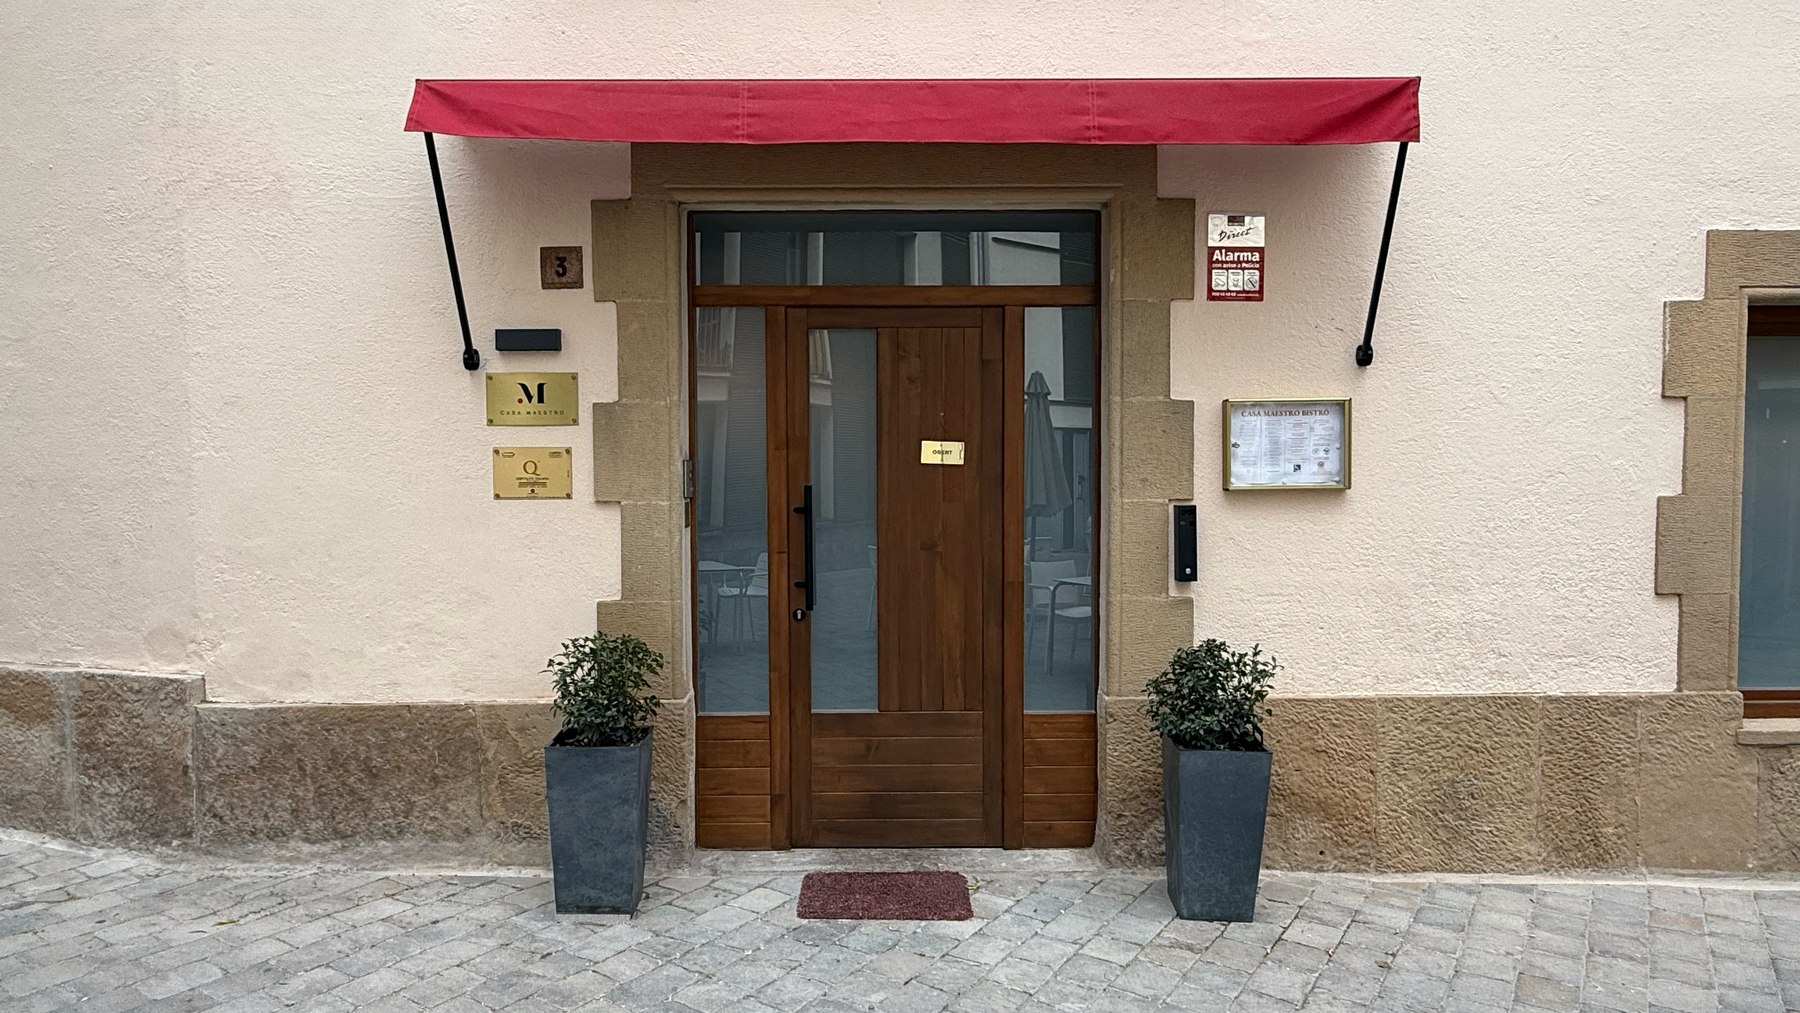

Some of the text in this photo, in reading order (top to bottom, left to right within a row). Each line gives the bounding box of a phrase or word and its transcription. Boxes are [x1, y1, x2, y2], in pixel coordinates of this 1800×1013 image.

[1212, 249, 1260, 261] Alarma
[555, 255, 567, 278] 3
[1263, 409, 1300, 417] MAESTRO
[1302, 408, 1330, 416] BISTRÓ
[523, 460, 541, 476] Q
